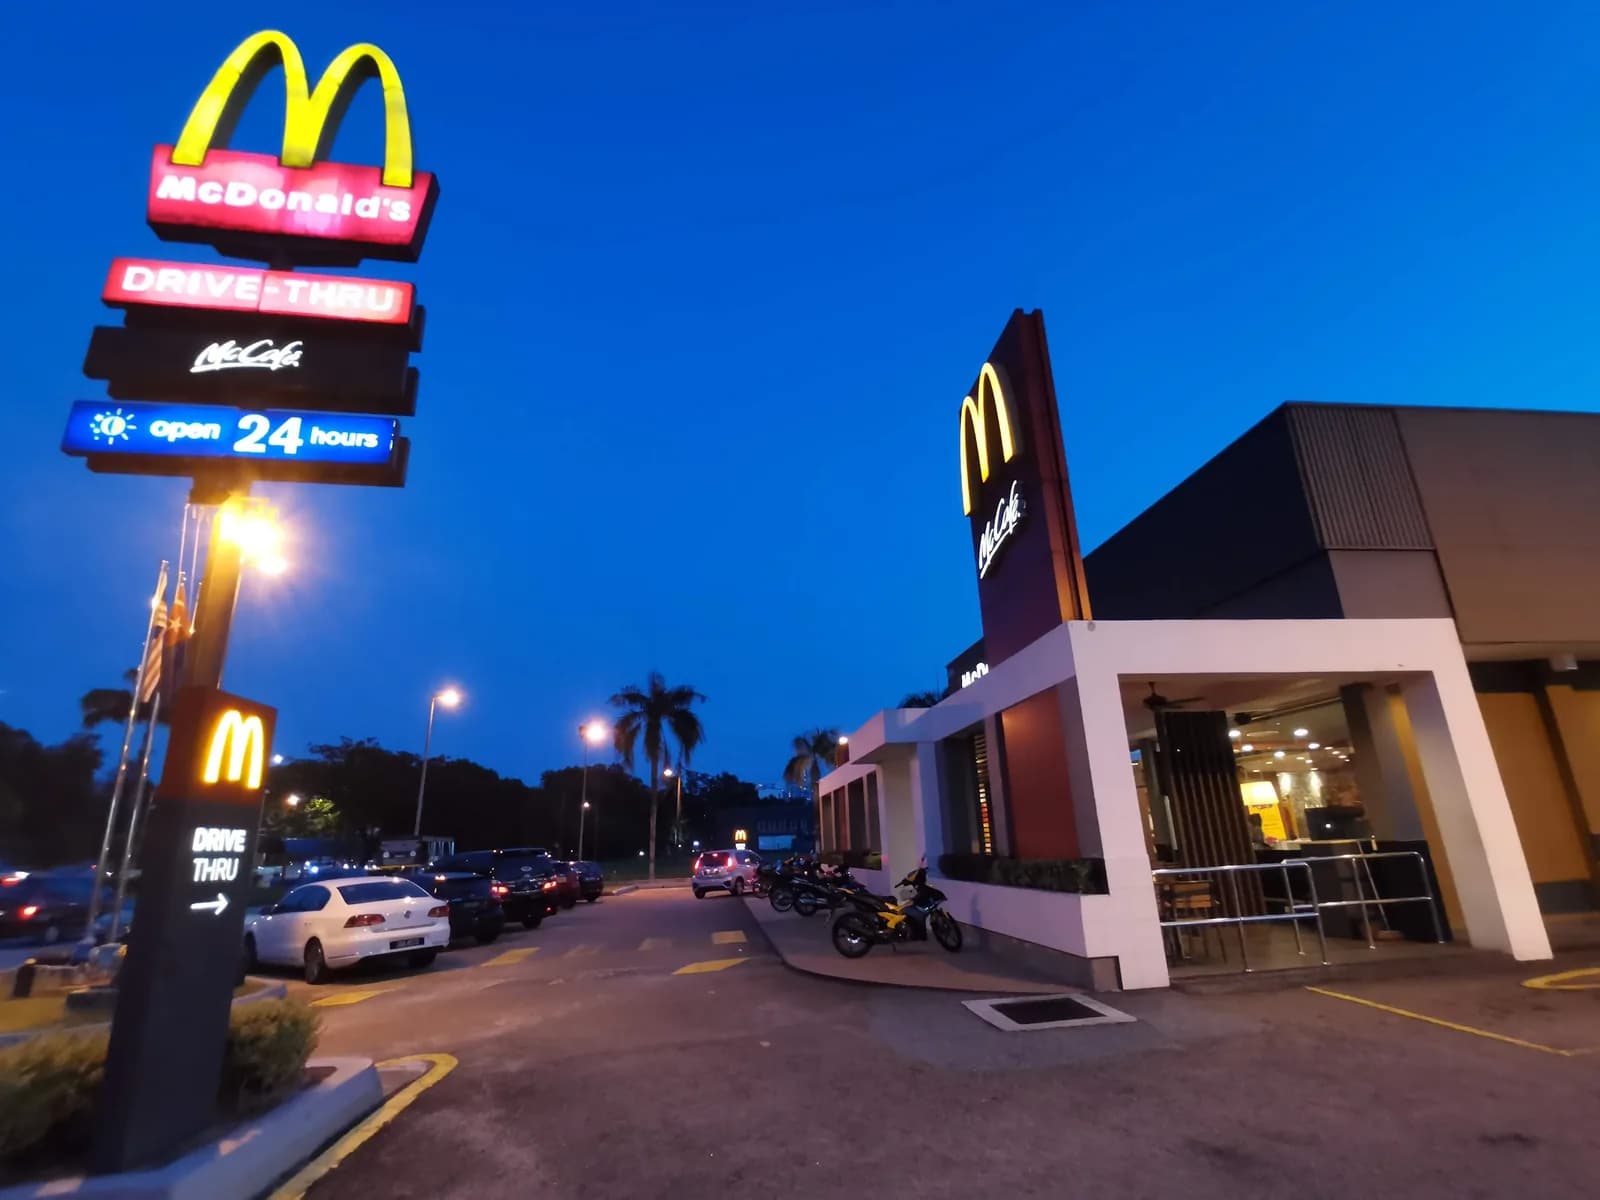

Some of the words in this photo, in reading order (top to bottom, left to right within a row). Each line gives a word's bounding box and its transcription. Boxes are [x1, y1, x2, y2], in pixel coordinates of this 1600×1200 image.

[156, 175, 411, 222] McDonald's
[121, 266, 395, 312] DRIVE-THRU
[150, 419, 221, 443] open
[233, 414, 304, 454] 24
[310, 427, 379, 448] hours
[192, 827, 247, 852] DRIVE
[193, 857, 240, 882] THRU
